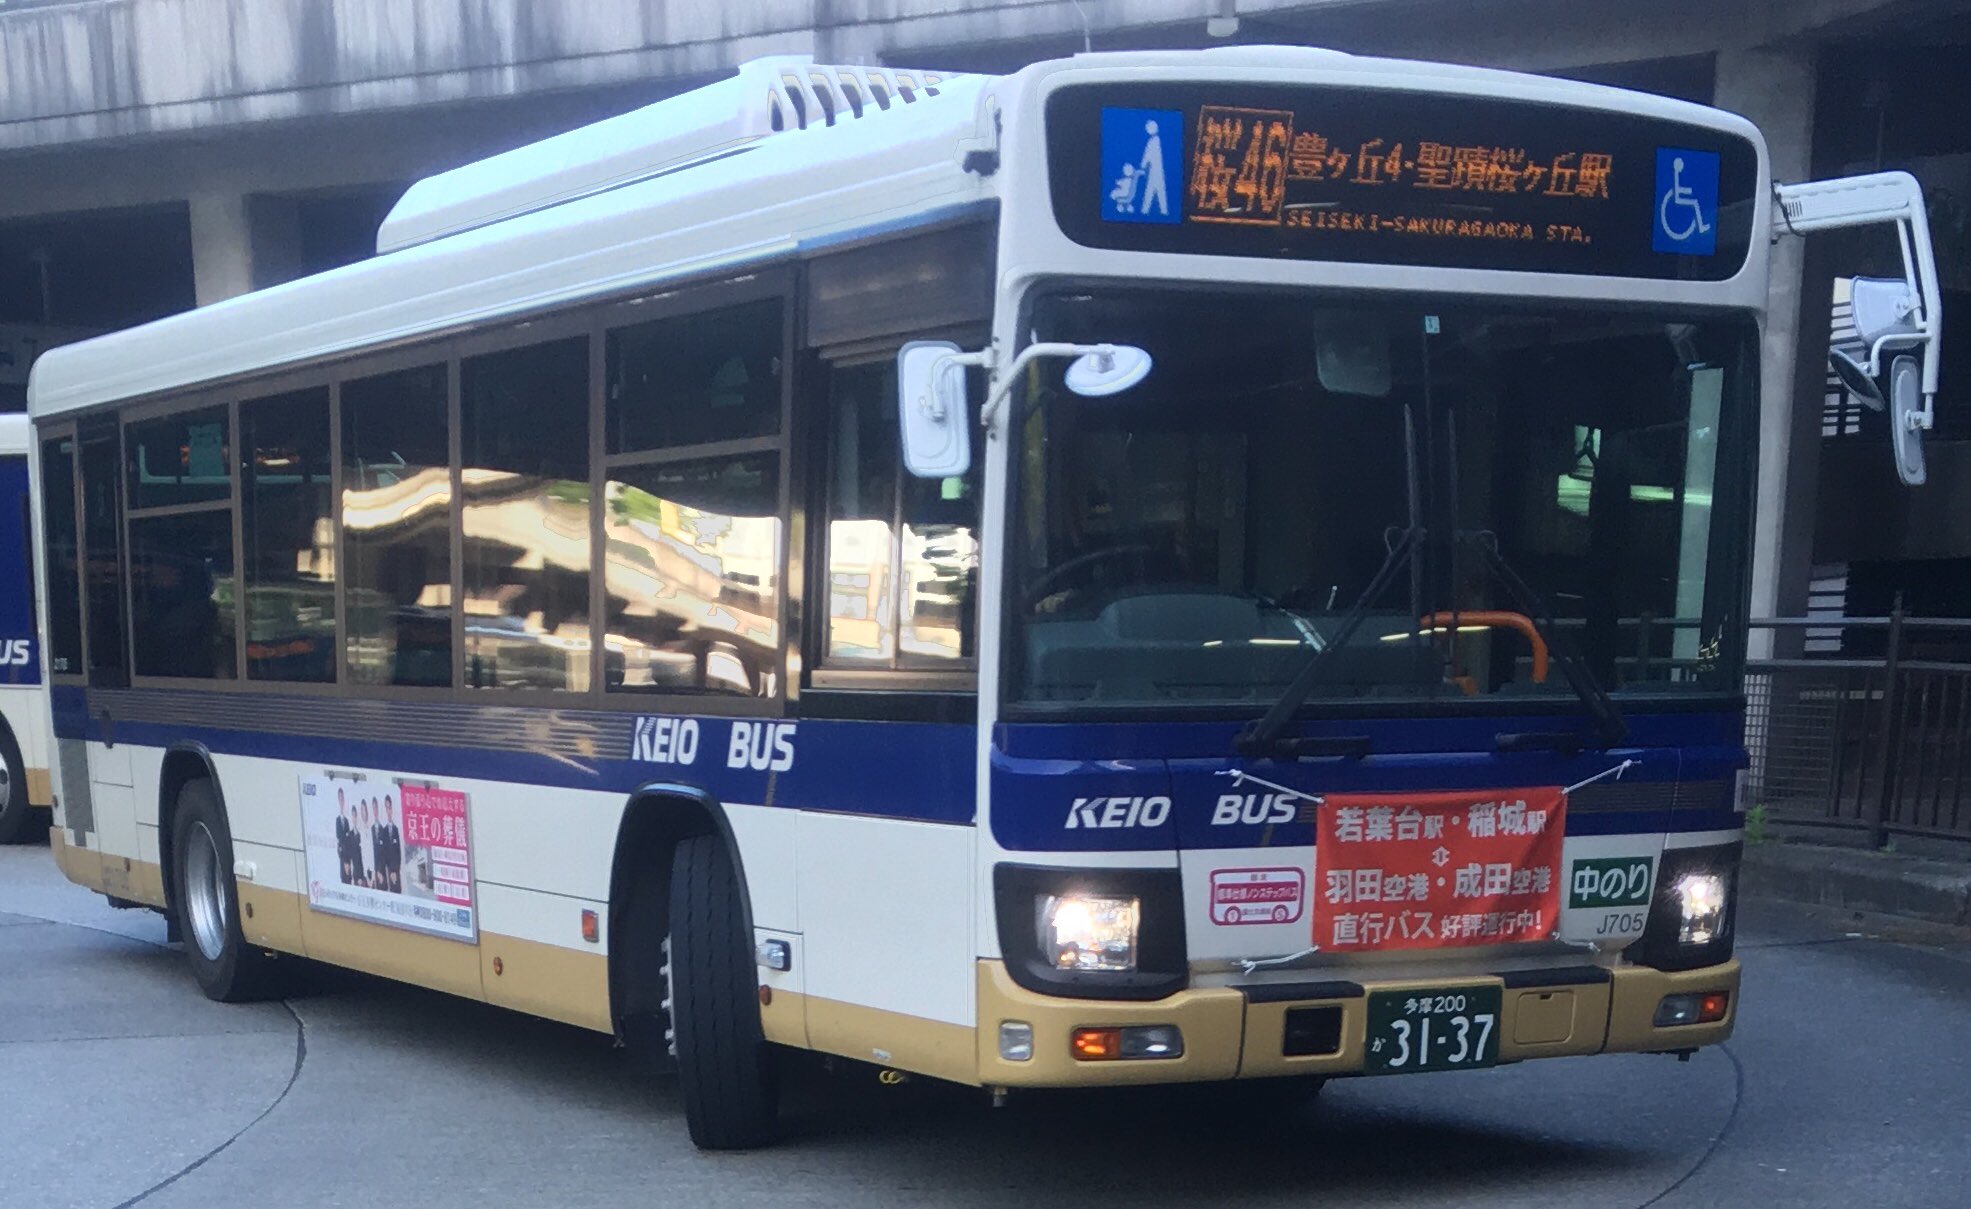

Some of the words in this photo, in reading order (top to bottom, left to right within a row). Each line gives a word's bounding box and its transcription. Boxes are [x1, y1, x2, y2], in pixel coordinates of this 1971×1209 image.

[1286, 208, 1534, 240] SEISEKI-SAKURAGAOKA
[1546, 223, 1592, 245] STA.
[632, 716, 699, 765] KEIO
[727, 721, 797, 772] BUS
[407, 810, 467, 847] 京王の葬儀
[1064, 796, 1172, 829] KEIO
[1211, 794, 1298, 825] BUS
[1335, 800, 1547, 842] 若葉台駅・稲城駅
[1325, 863, 1551, 904] 羽田空港・成田空港
[1574, 865, 1649, 901] 中のり
[1333, 909, 1435, 945] 直行バス
[1597, 913, 1644, 935] J705
[1389, 1014, 1494, 1067] 31-37
